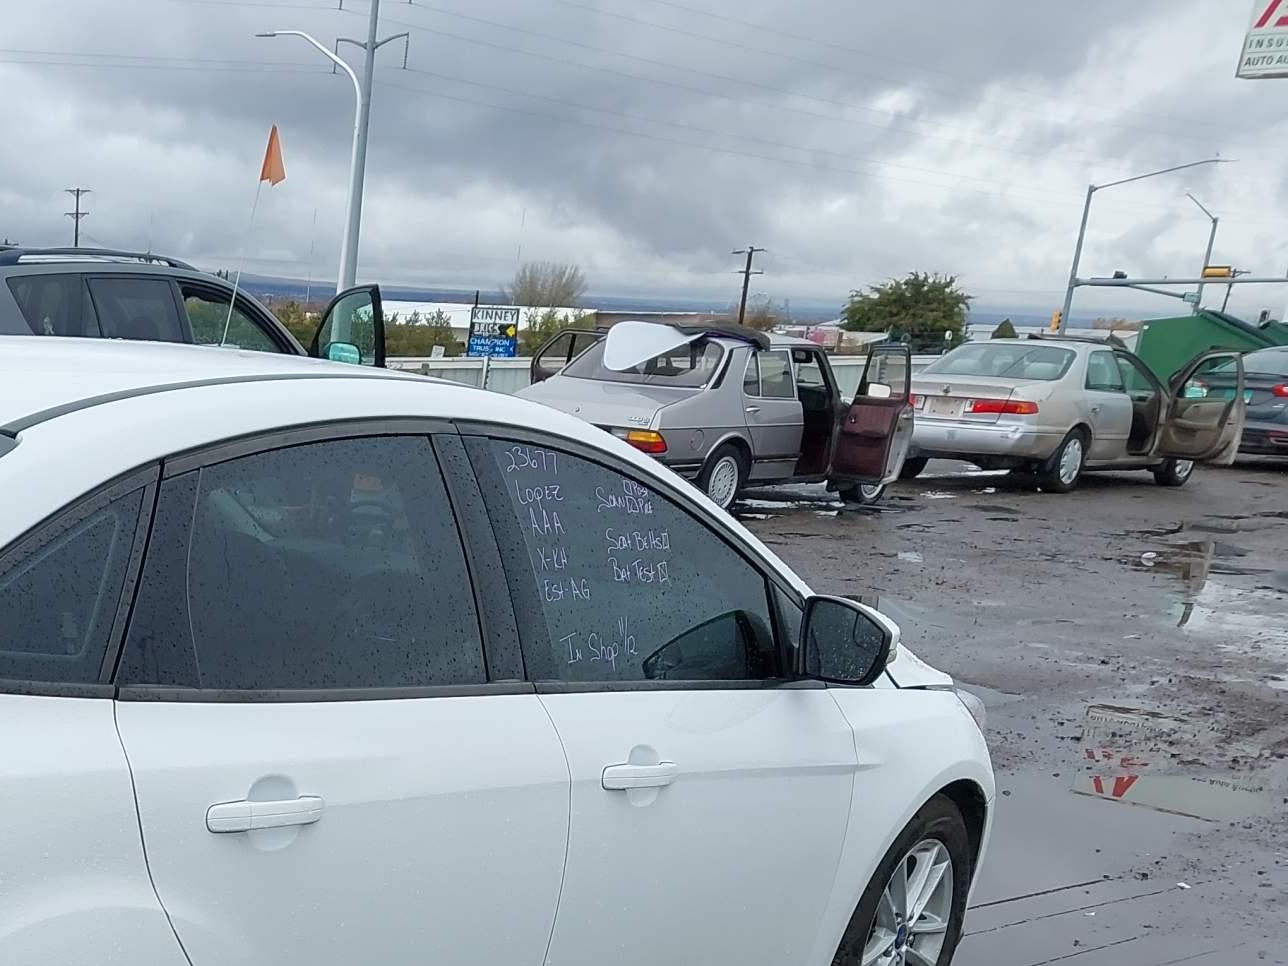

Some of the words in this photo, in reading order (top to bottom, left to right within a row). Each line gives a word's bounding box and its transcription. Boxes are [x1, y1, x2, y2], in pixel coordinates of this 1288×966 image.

[1248, 37, 1288, 49] INSU
[1244, 56, 1274, 67] AUTO
[473, 309, 517, 322] KINNEY
[504, 446, 558, 475] 23677
[529, 506, 566, 537] AAA
